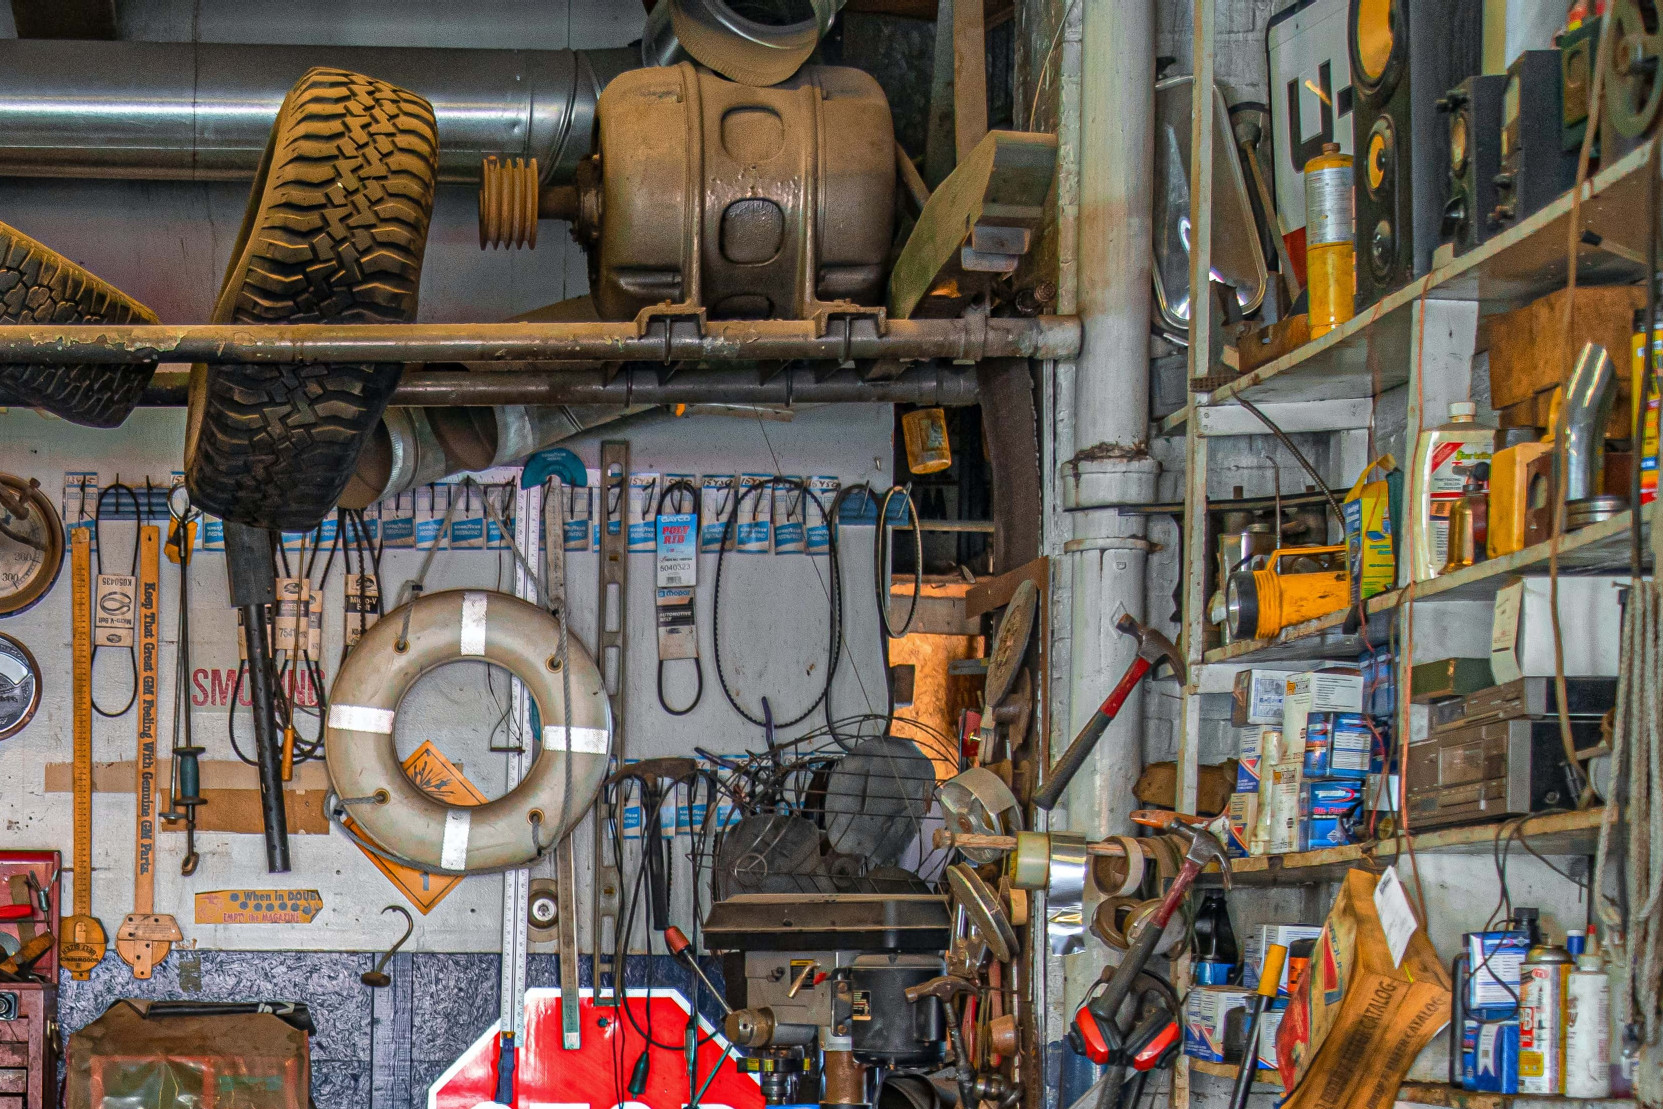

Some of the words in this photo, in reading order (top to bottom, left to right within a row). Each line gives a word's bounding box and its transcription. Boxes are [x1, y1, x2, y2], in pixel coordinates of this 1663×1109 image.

[141, 582, 155, 610] Keep
[143, 612, 155, 638] That
[143, 642, 155, 672] Great
[143, 676, 154, 695] GM
[192, 668, 326, 707] SMOING
[139, 699, 154, 740] Feeling
[142, 741, 154, 769] With
[141, 772, 154, 817] Genuine
[141, 820, 152, 839] GM
[244, 891, 272, 902] When
[275, 890, 284, 902] in
[287, 891, 321, 902] DOUB
[223, 912, 246, 923] EMPTY
[248, 912, 259, 922] the
[1362, 980, 1398, 1031] CATALOG
